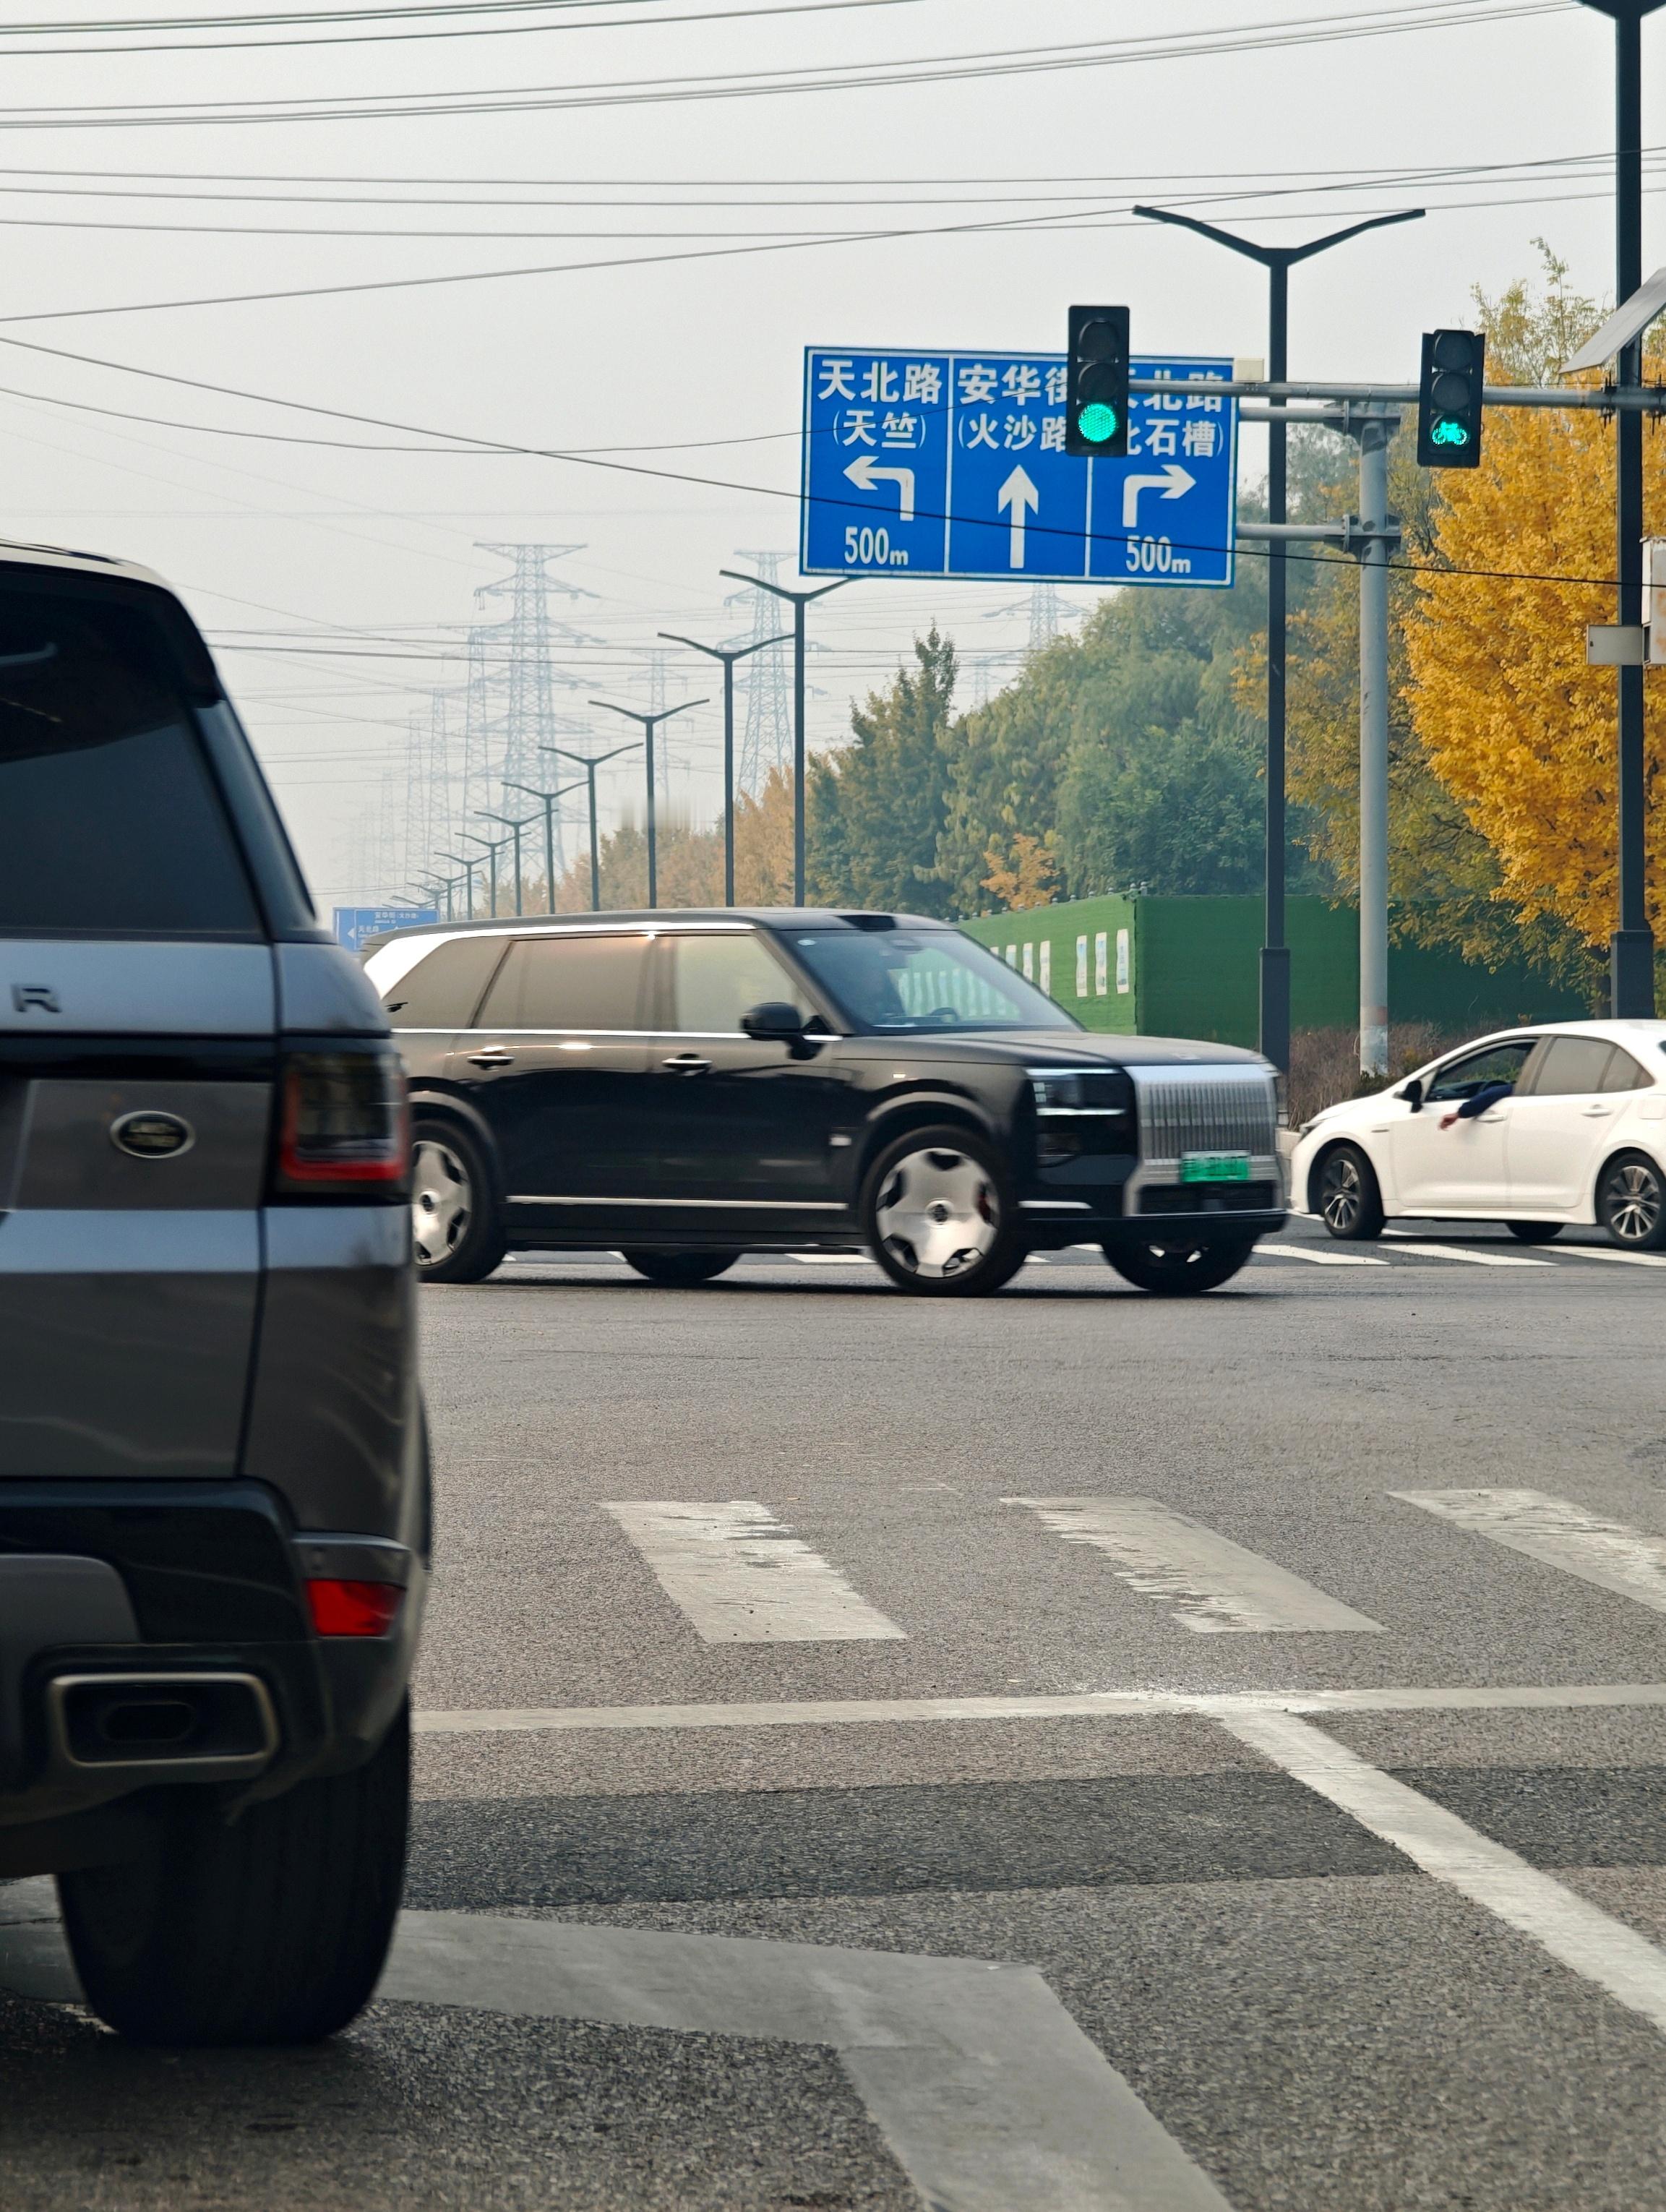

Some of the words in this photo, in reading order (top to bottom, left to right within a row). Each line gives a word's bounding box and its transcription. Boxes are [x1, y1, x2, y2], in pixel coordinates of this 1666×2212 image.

[817, 359, 943, 404] 天北路
[1128, 367, 1224, 413] 北路
[833, 410, 926, 449] (天竺)
[844, 526, 909, 565] 500m
[1125, 535, 1191, 573] 500m
